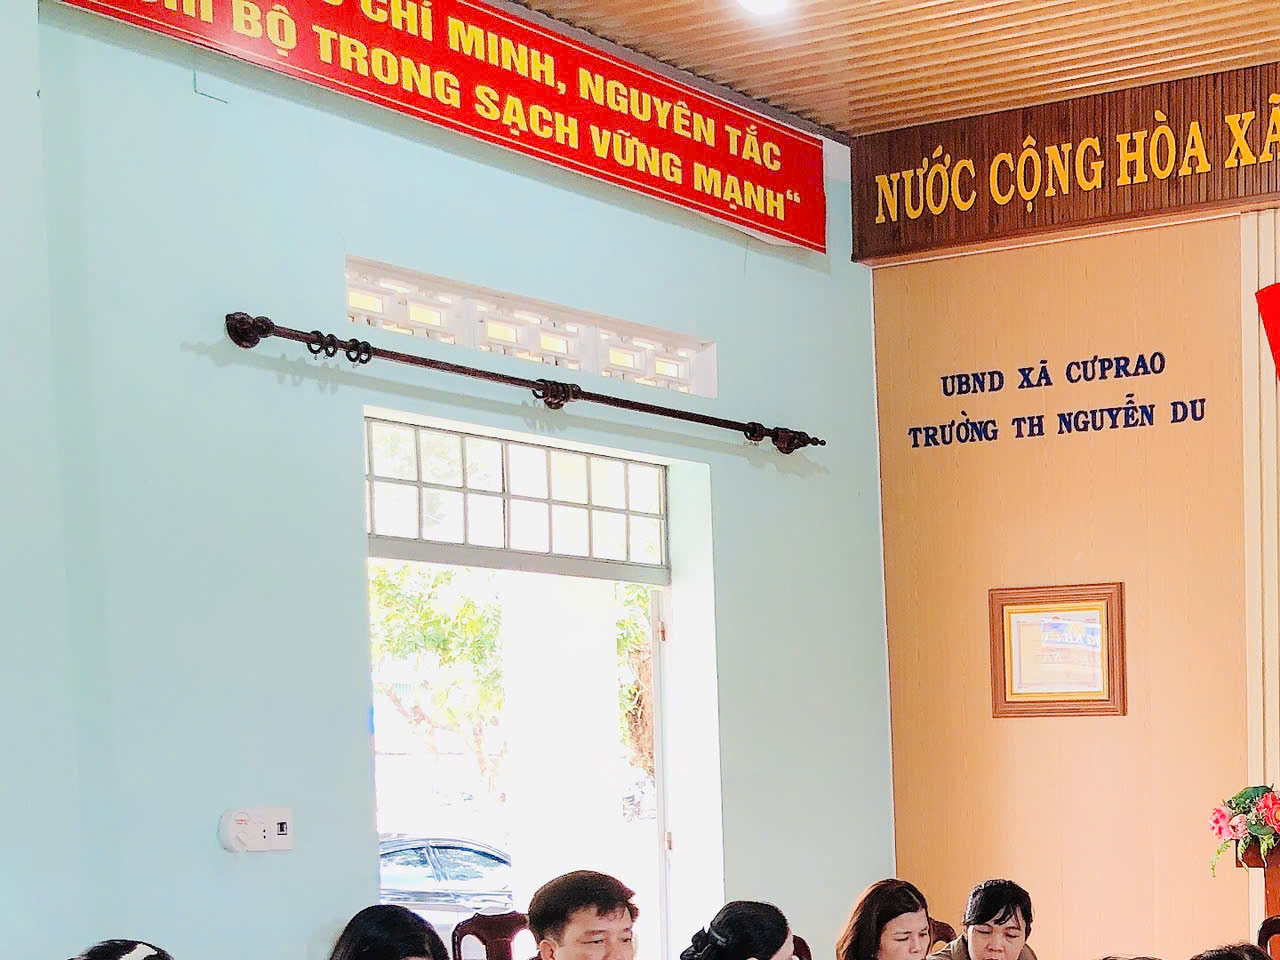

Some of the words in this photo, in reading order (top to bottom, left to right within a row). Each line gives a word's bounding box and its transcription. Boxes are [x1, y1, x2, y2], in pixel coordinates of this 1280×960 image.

[231, 0, 298, 57] BỘ
[311, 25, 461, 108] TRONG
[474, 85, 579, 149] SẠCH
[589, 125, 683, 184] VỮNG
[360, 0, 432, 42] CHÍ
[448, 23, 567, 95] MINH,
[579, 67, 715, 147] NGUYÊN
[725, 123, 782, 171] TẮC
[875, 145, 977, 224] NƯỚC
[989, 135, 1105, 214] CỘNG
[1115, 110, 1211, 186] HÒA
[907, 410, 999, 449] TRƯỜNG
[1011, 414, 1045, 439] TH
[1056, 393, 1156, 435] NGUYỄN
[1170, 397, 1206, 424] DU
[940, 370, 1005, 397] UBND
[1017, 359, 1053, 390] XÃ
